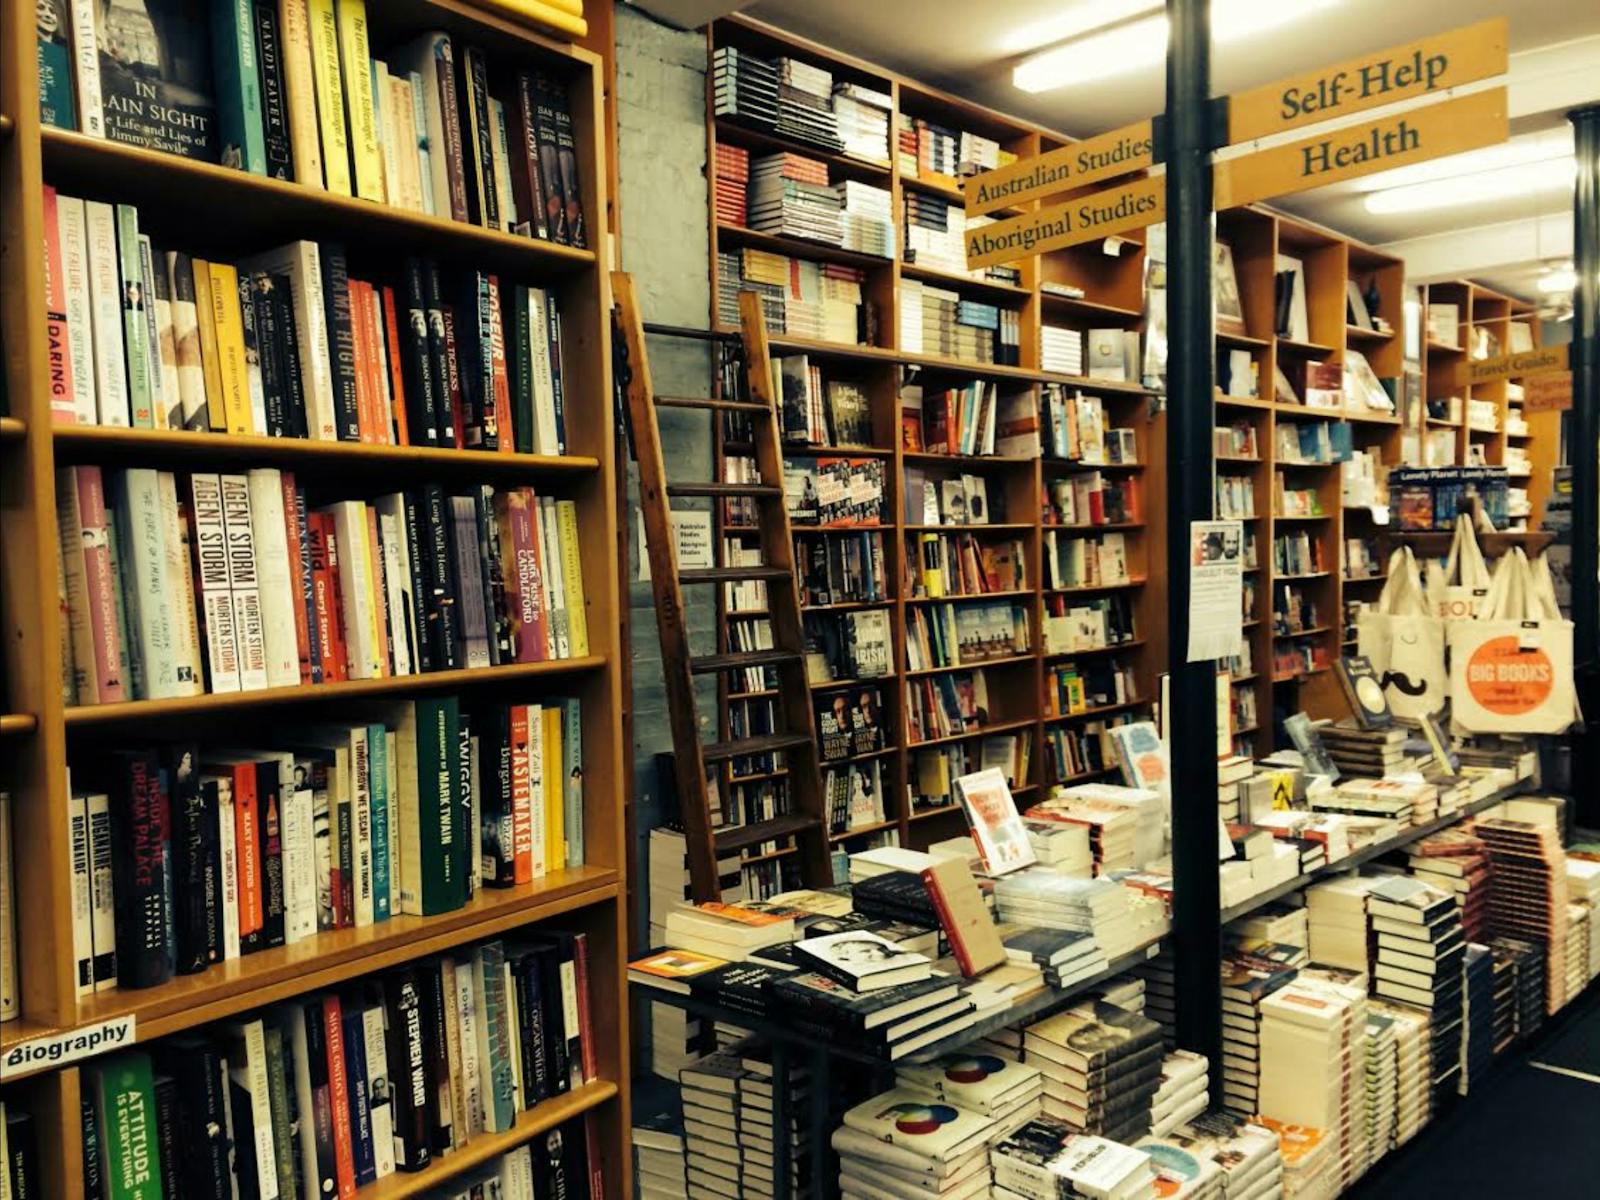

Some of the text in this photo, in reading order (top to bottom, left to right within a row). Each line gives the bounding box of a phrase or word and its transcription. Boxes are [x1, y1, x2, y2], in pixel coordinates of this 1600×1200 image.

[135, 81, 156, 99] IN
[261, 18, 280, 127] MANDY SAYER
[328, 64, 338, 87] Arthur
[359, 71, 370, 95] Arthur
[1280, 48, 1449, 123] Self-Help
[103, 96, 208, 132] AIN SIGHT
[110, 126, 189, 155] Jimmy Savile
[116, 117, 141, 133] Life
[145, 124, 165, 138] and
[169, 127, 192, 143] Lies
[194, 136, 206, 147] of
[526, 127, 538, 160] LOVE
[974, 136, 1153, 205] Australian Studies
[1300, 121, 1420, 178] Health
[967, 192, 1157, 260] Aboriginal Studies
[68, 251, 82, 293] FAILURE
[239, 276, 255, 332] Nigel Slater
[331, 256, 355, 376] DRAMA HIGH
[489, 283, 504, 361] POSEUR
[48, 325, 66, 396] DARING
[445, 312, 459, 392] TAMIL TIGRESS
[420, 354, 433, 413] SUSAN SONTAG
[439, 354, 451, 412] SUSAN SONTAG
[194, 479, 228, 584] AGENT STORM
[223, 481, 256, 584] AGENT STORM
[295, 495, 313, 600] HELEN SUZMAN
[309, 530, 325, 571] wild
[430, 499, 447, 584] Long Walk Home
[517, 549, 533, 623] CANDLEFORD
[526, 549, 536, 579] LARK
[316, 580, 331, 658] Cheryl Strayed
[530, 582, 539, 607] RISE
[216, 596, 236, 673] MORTEN STORM
[245, 595, 264, 671] MORTEN STORM
[1469, 663, 1550, 682] BIG BOOKS
[531, 717, 540, 751] Saving
[355, 739, 368, 792] TOMORROW
[438, 770, 451, 806] MARK
[459, 727, 470, 808] TWIGGY
[500, 747, 512, 799] Bargain
[132, 762, 151, 887] DREAM PALACE
[149, 777, 163, 868] INSIDE THE
[359, 795, 368, 808] WE
[359, 811, 369, 843] ESCAPE
[440, 807, 453, 845] TWAIN
[513, 747, 531, 855] TASTEMAKER
[244, 811, 254, 888] MARY POPPINS
[205, 866, 216, 947] INVISIBLE WOMAN
[328, 1012, 341, 1053] MISTER
[461, 987, 471, 1032] ROMANY
[531, 1009, 541, 1047] OSCAR
[6, 1023, 129, 1067] Biography
[406, 1008, 426, 1107] STEPHEN WARD
[83, 1106, 98, 1187] TIM WINTON
[116, 1093, 134, 1190] IS EVERYTHING
[127, 1090, 150, 1185] ATTITUDE
